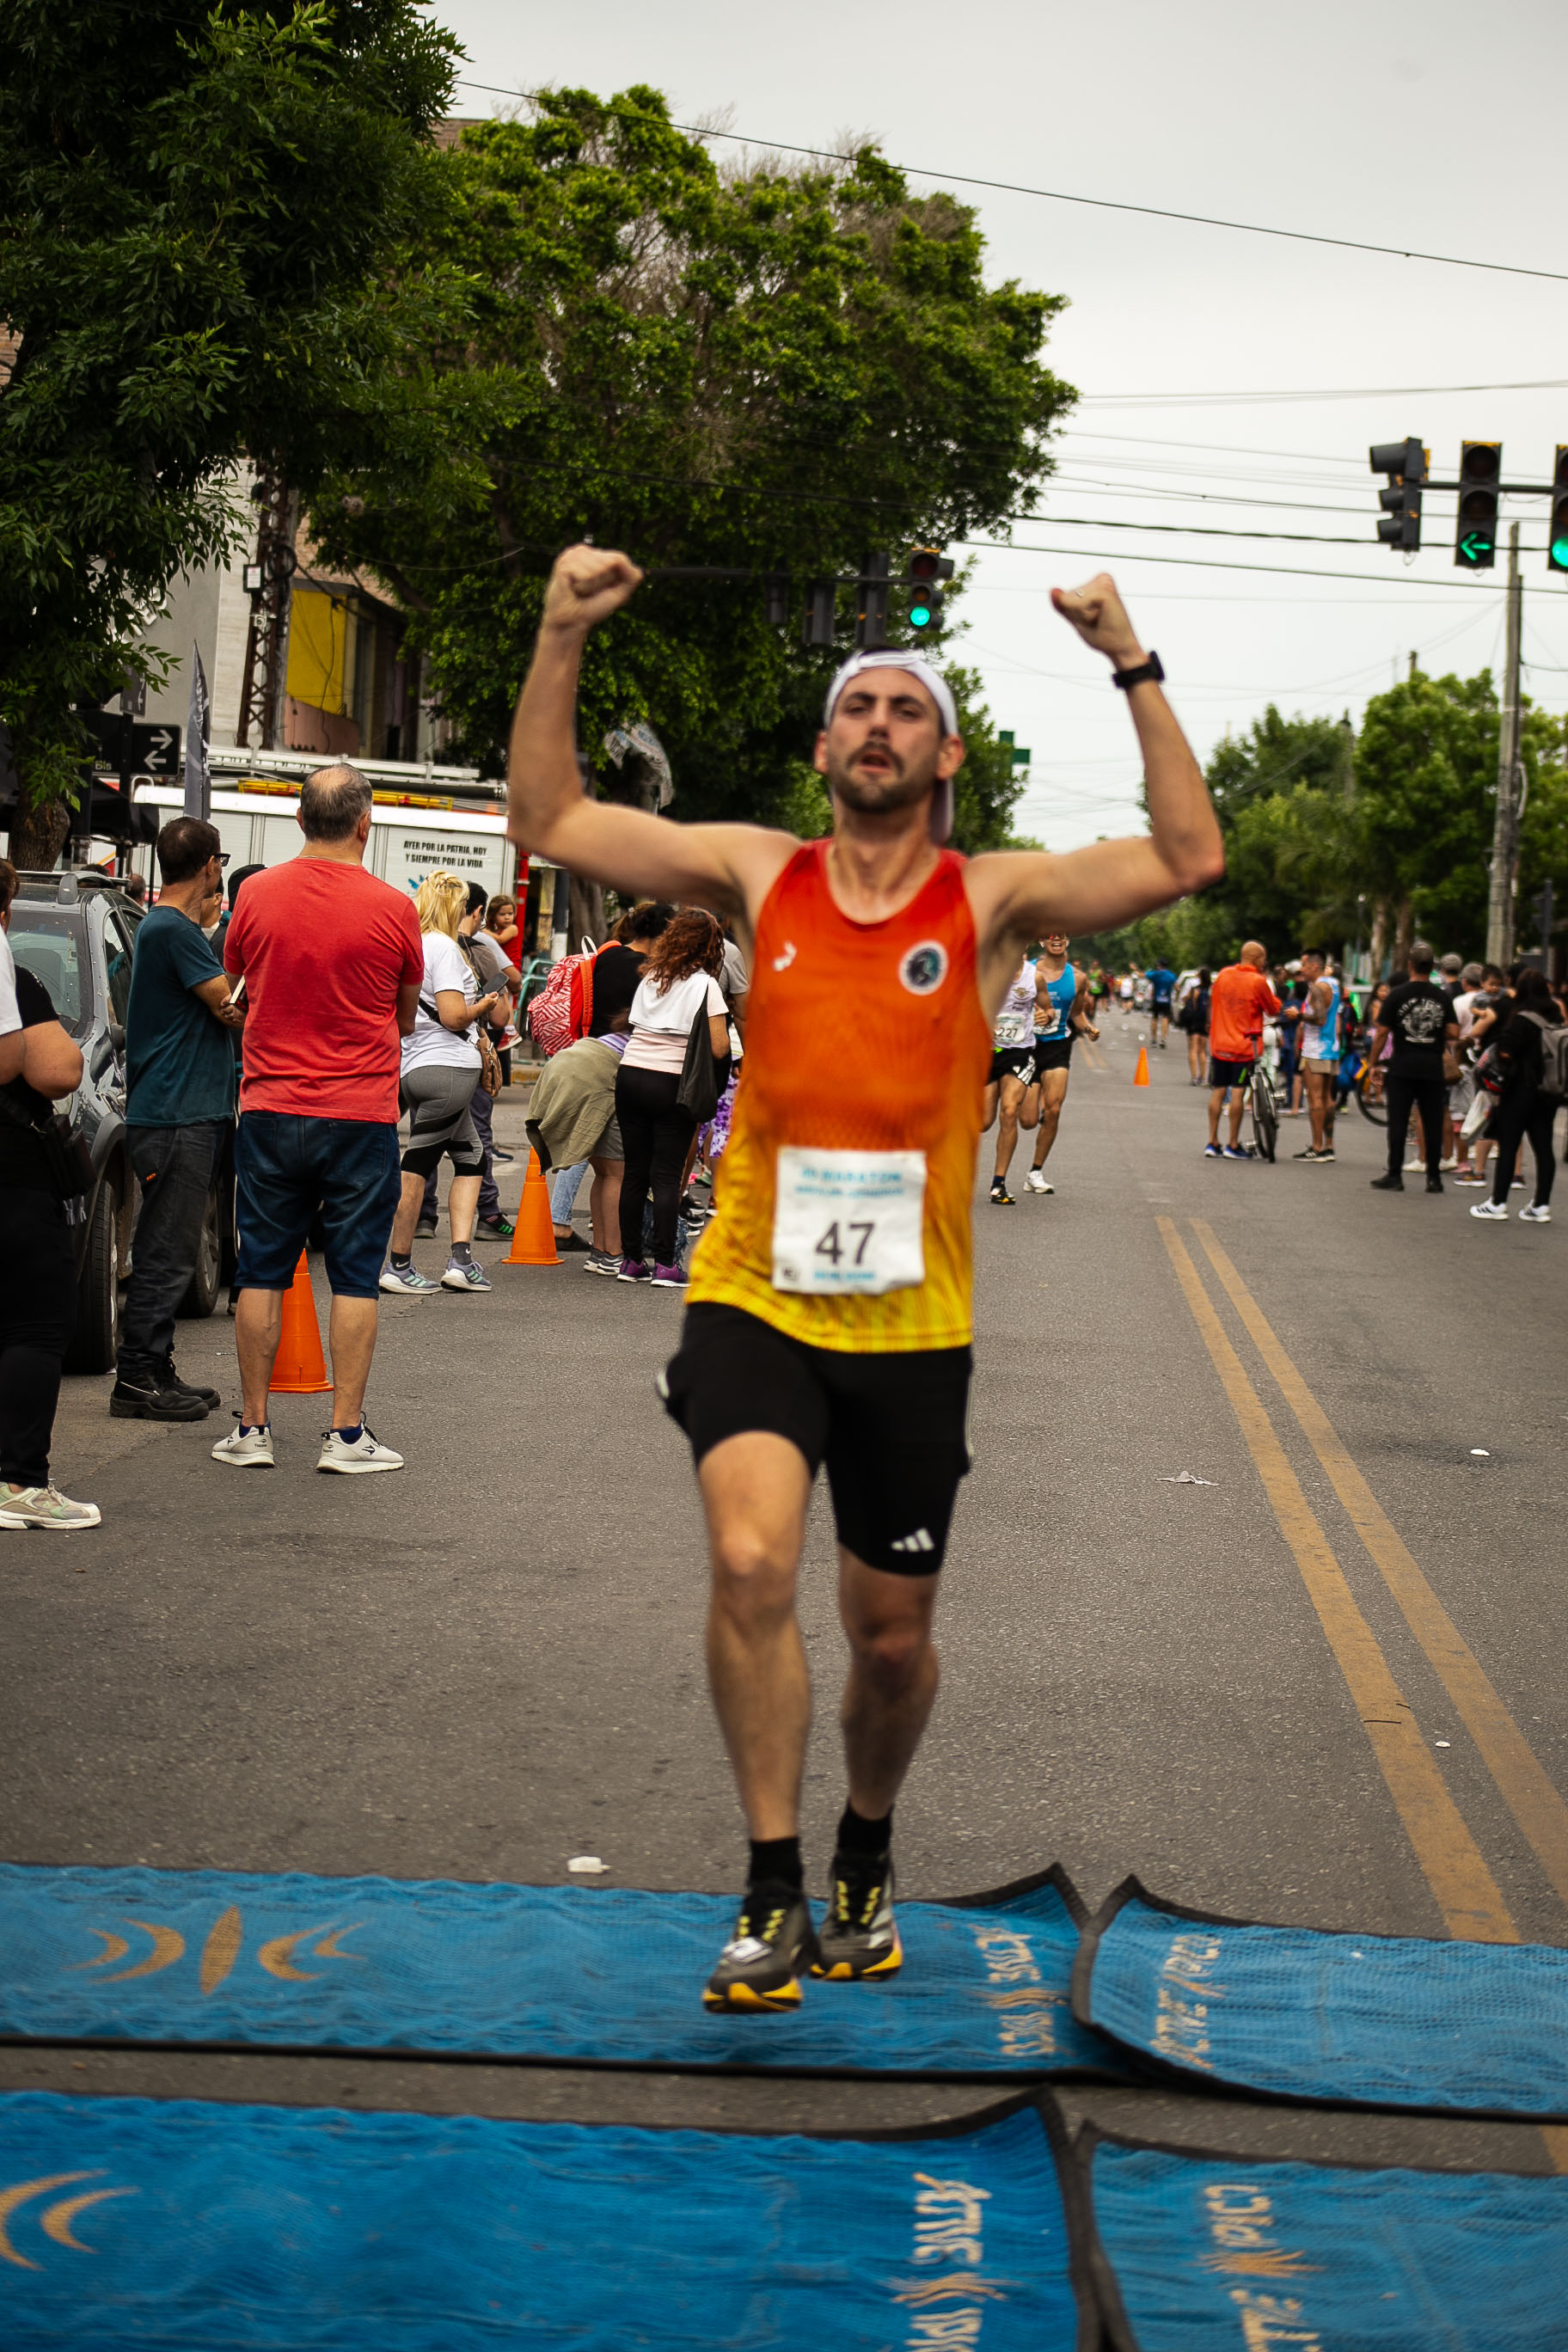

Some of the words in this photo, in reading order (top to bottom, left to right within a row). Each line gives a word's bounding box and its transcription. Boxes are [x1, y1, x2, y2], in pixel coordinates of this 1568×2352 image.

[403, 840, 420, 850] AYER
[421, 842, 436, 852] POR
[437, 842, 445, 853] LA
[473, 846, 487, 856] HOY
[406, 853, 410, 862] Y
[411, 854, 440, 865] SIEMPRE
[442, 856, 456, 867] POR
[457, 858, 465, 867] LA
[467, 859, 483, 869] VIDA
[998, 1026, 1019, 1038] 227
[814, 1221, 875, 1266] 47
